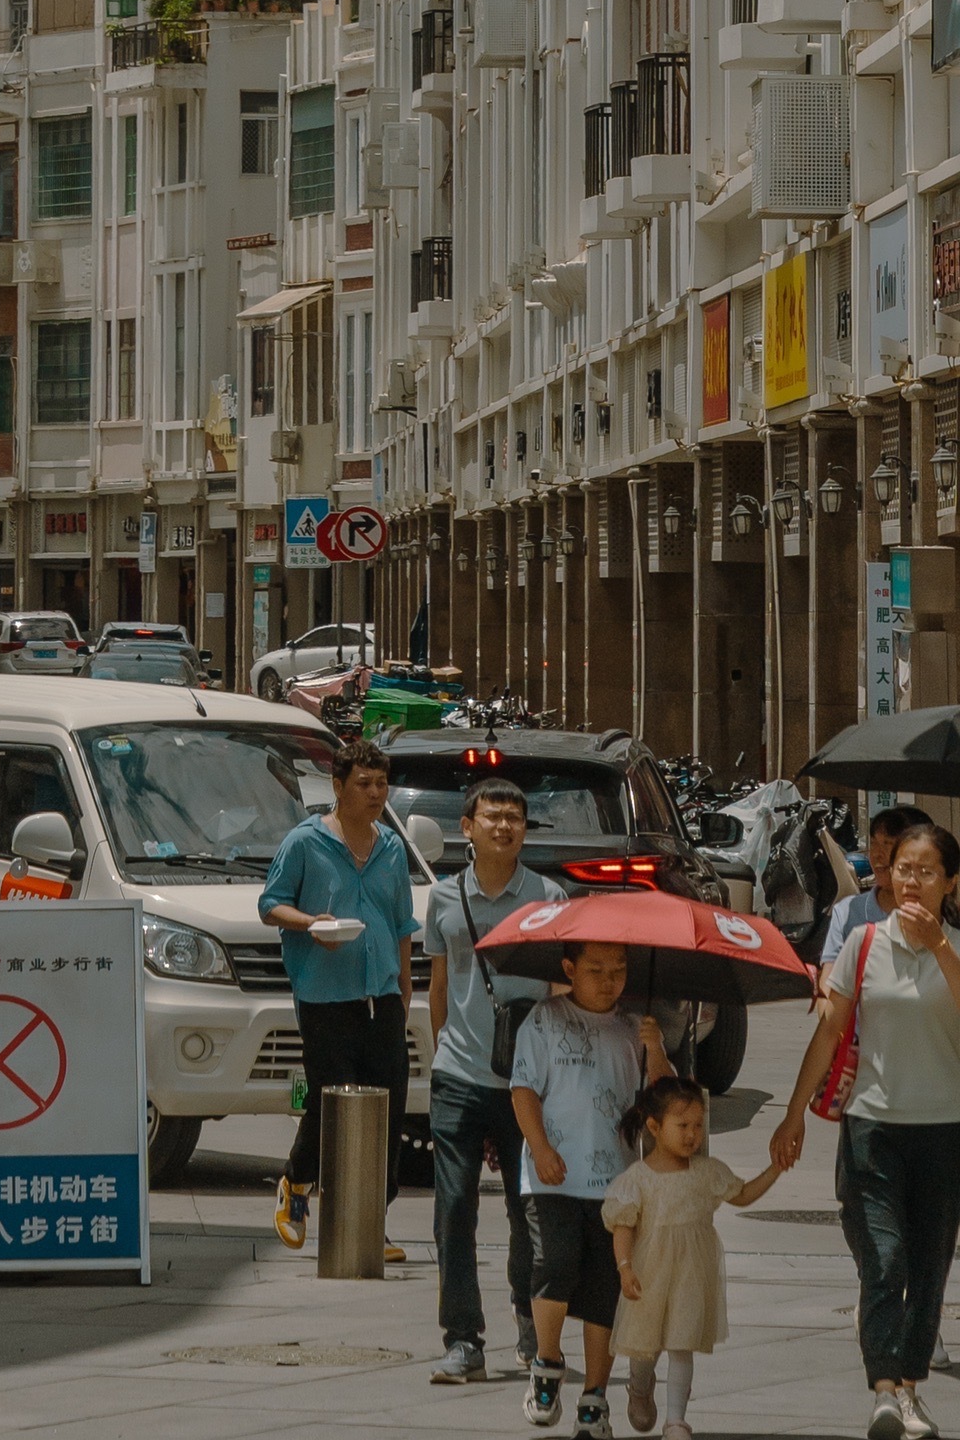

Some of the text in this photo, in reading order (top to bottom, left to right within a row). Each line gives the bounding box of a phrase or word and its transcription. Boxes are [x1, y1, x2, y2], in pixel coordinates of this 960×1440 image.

[290, 547, 322, 555] 礼让行
[7, 957, 113, 972] 商业步行街
